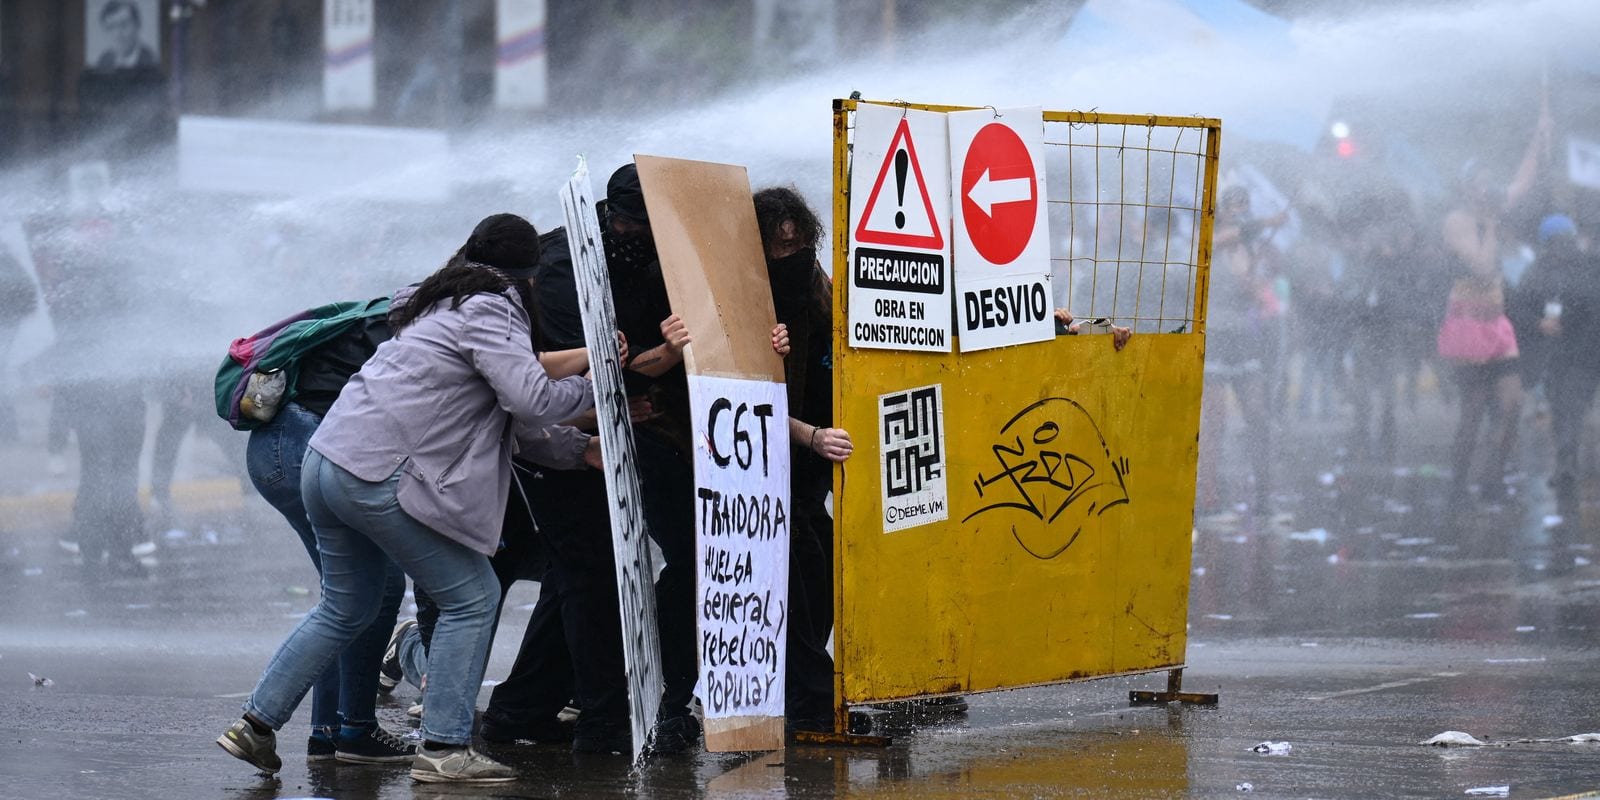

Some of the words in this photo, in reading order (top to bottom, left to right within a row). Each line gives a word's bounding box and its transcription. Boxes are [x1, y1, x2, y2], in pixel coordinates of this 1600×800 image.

[859, 256, 939, 285] PRECAUCION
[874, 298, 906, 319] OBRA
[909, 300, 925, 320] EN
[964, 282, 1047, 331] DESVIO
[854, 322, 944, 347] CONSTRUCCION
[707, 397, 774, 478] CGT
[698, 487, 787, 542] TRAIDORA
[705, 544, 752, 587] HUELGA
